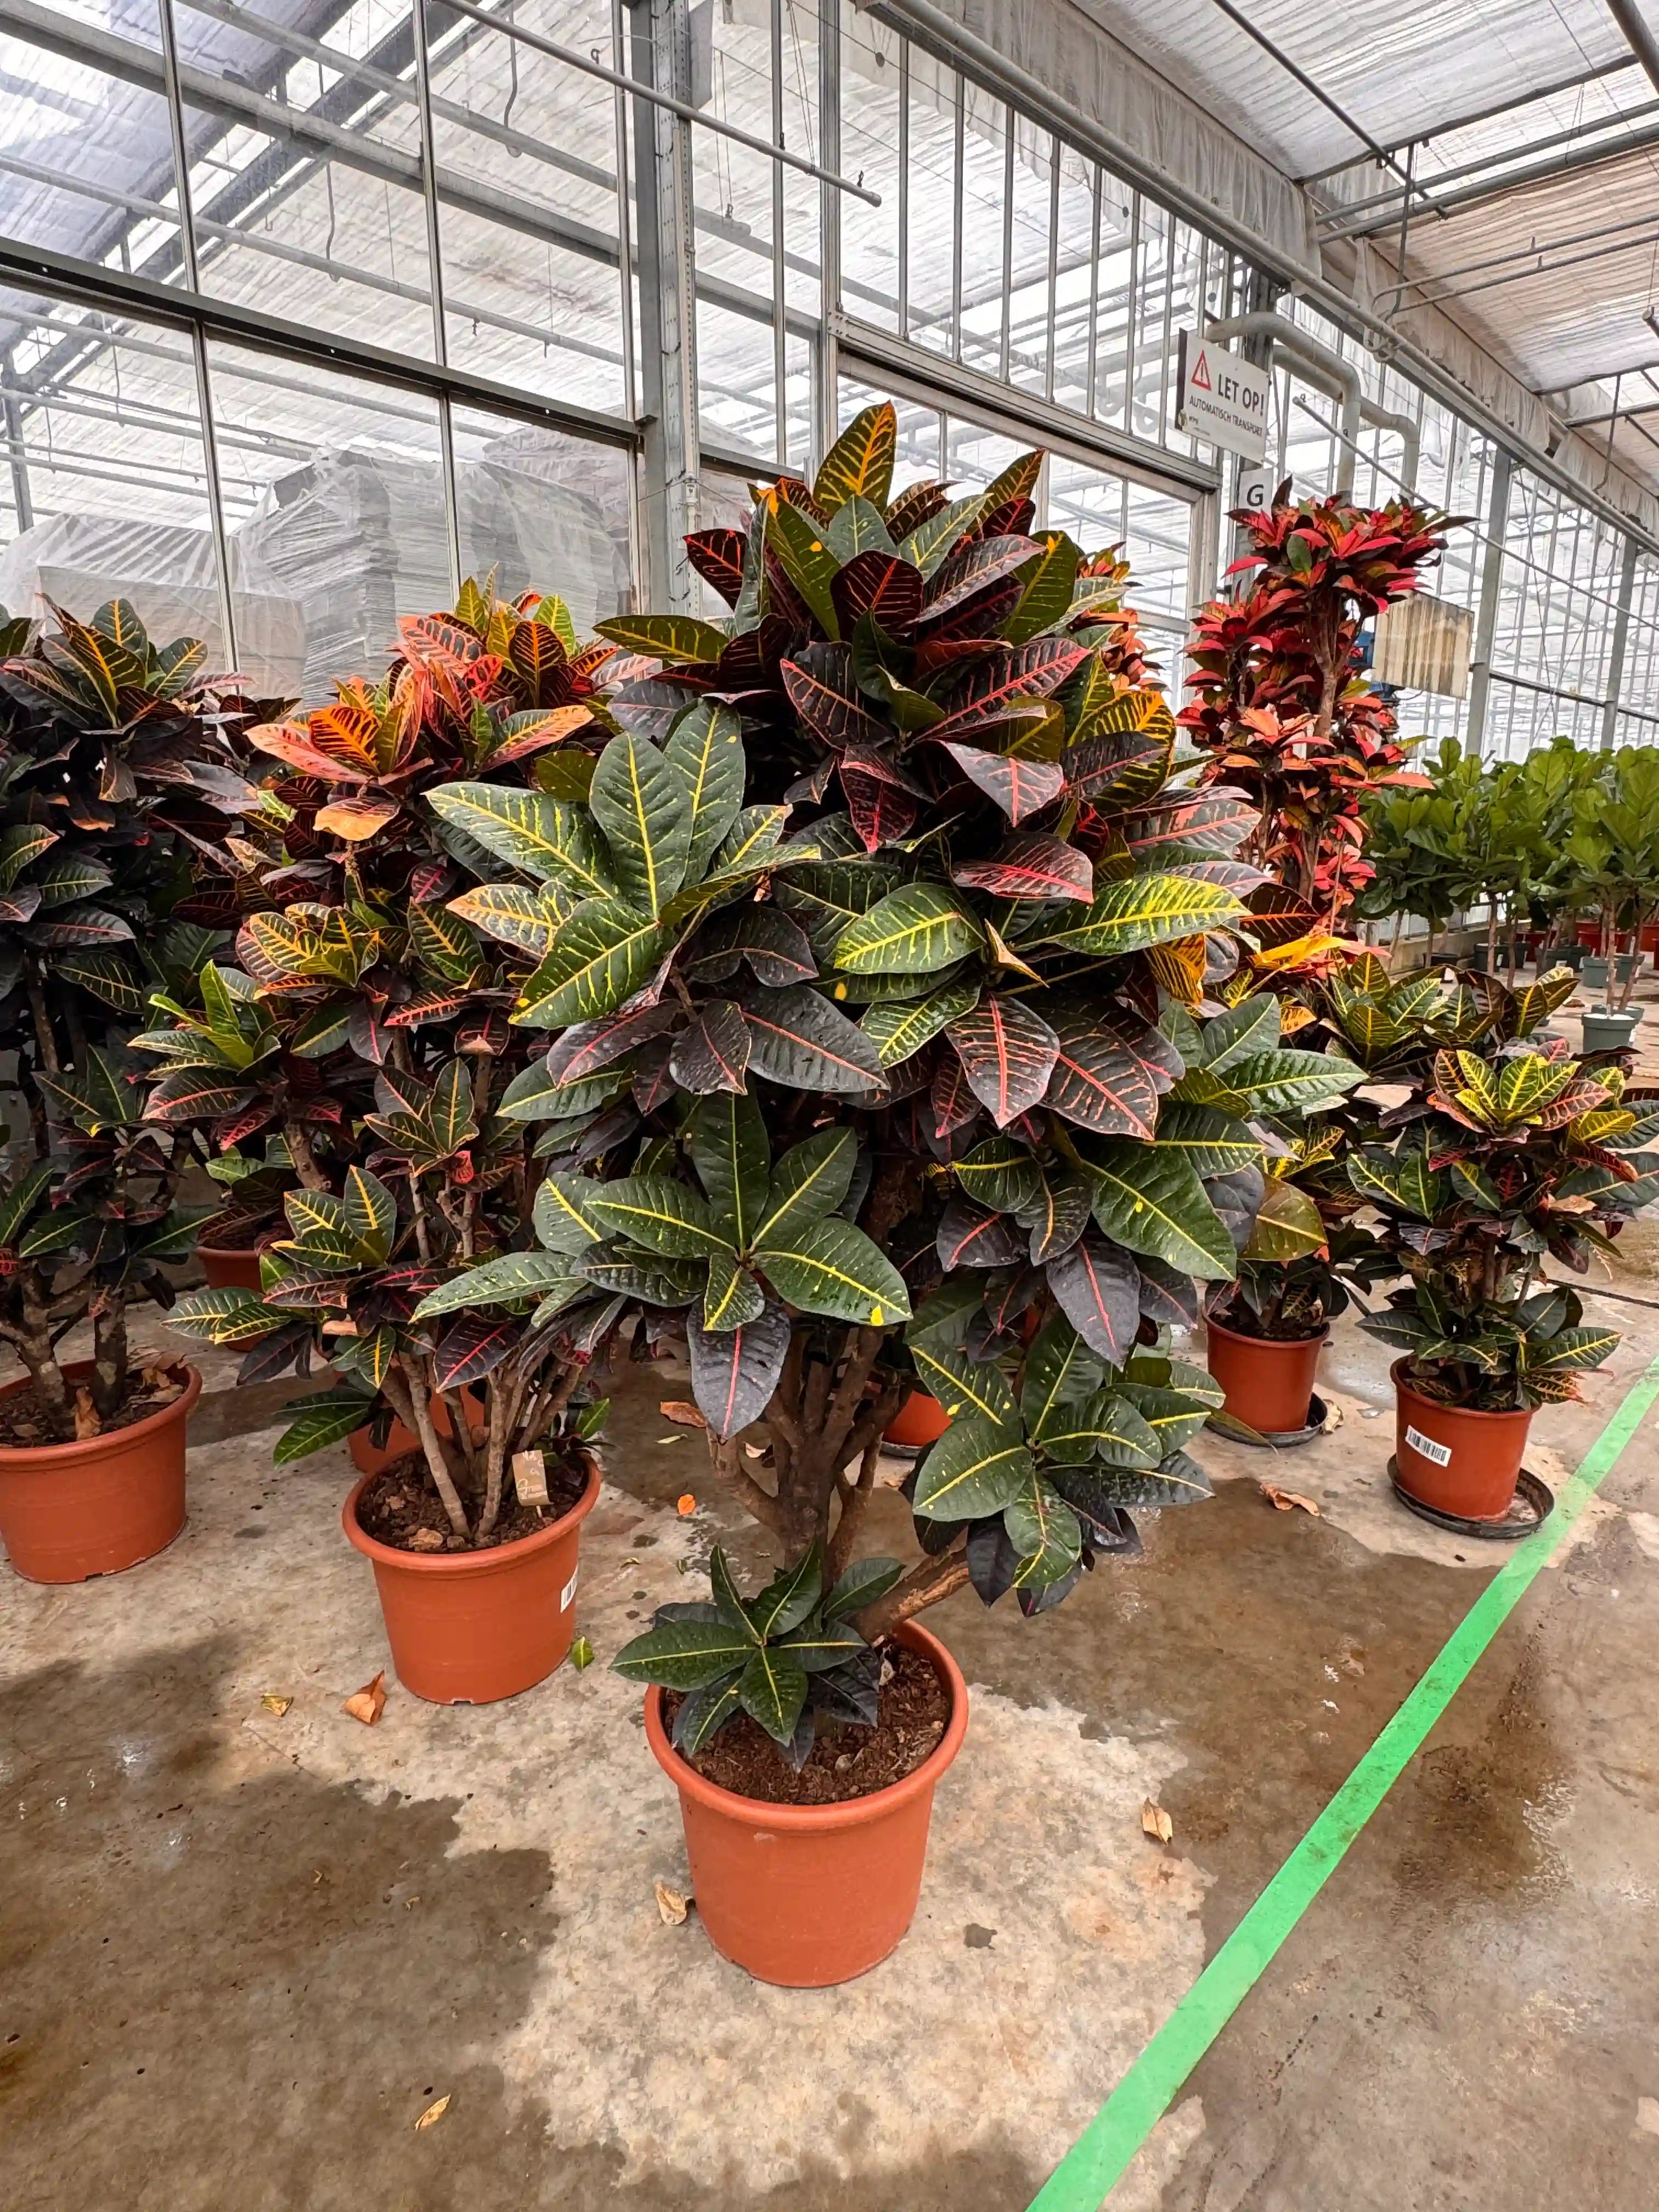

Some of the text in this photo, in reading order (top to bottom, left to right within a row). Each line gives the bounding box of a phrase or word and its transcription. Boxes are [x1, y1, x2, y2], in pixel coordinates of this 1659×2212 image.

[1189, 395, 1262, 437] AUTOMATISCH TRANSPORT
[1218, 373, 1264, 417] LET OP!
[1246, 484, 1264, 506] G
